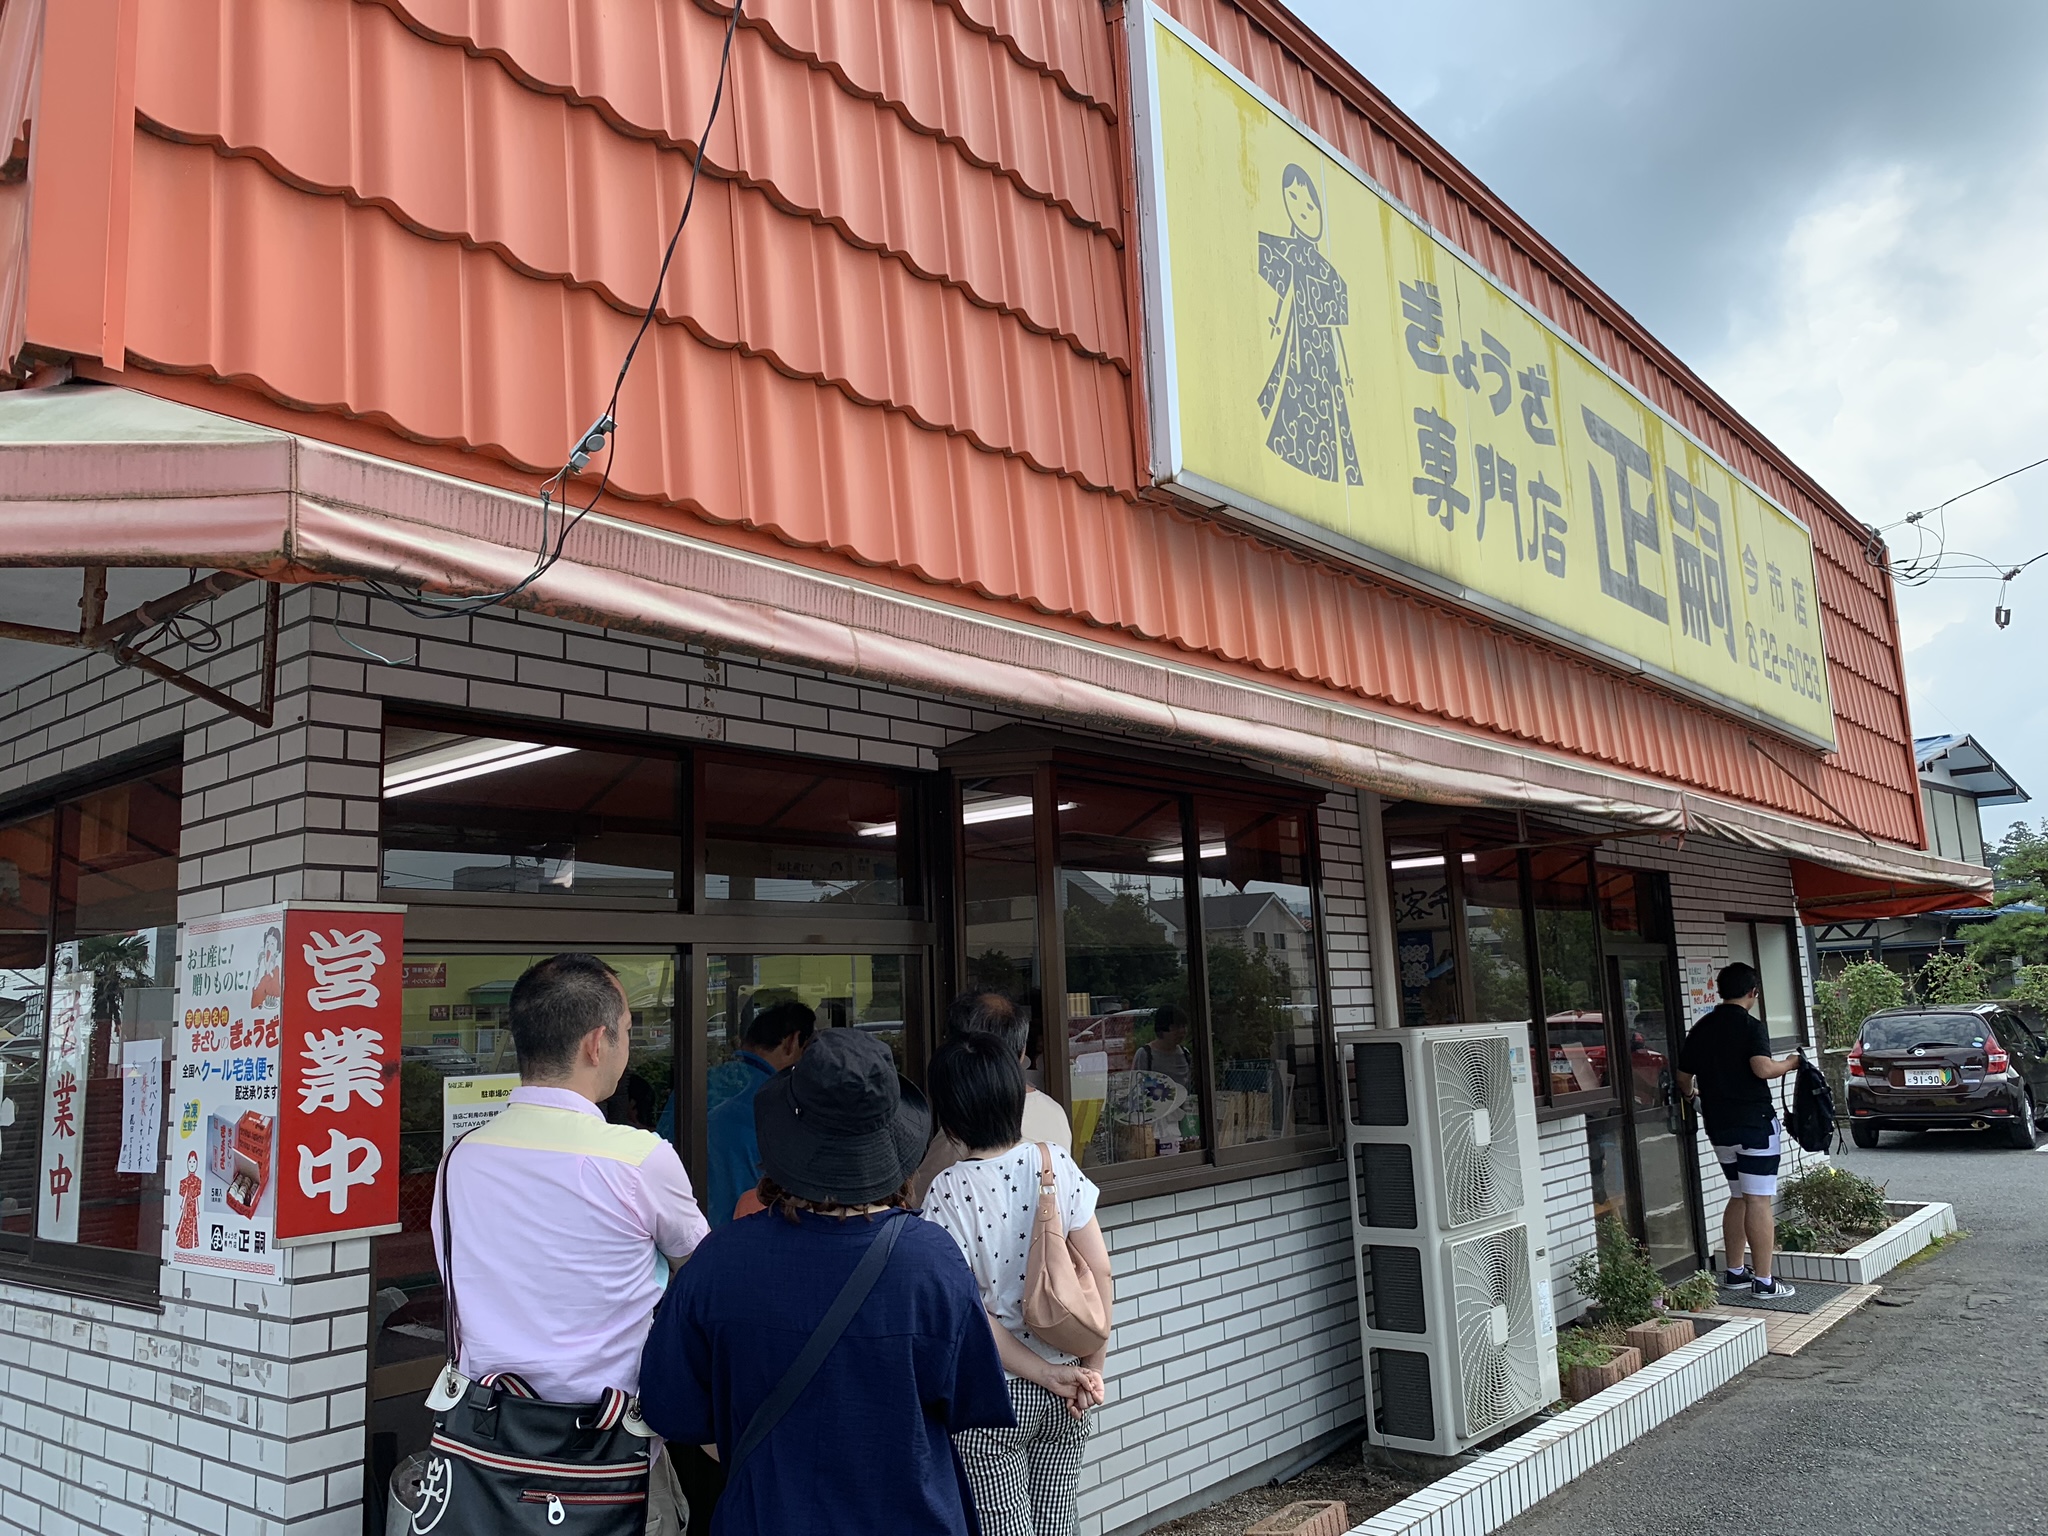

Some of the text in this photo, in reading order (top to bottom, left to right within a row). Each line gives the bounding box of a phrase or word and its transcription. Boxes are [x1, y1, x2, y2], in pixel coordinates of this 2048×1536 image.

[1399, 278, 1556, 447] ぎょうざ
[1412, 406, 1566, 579] 専門店
[1580, 403, 1738, 664] 正嗣
[1742, 543, 1808, 629] 今市店
[1760, 627, 1822, 703] 22-6083
[235, 1085, 278, 1101] 配送承ります
[297, 928, 386, 1214] 営業中
